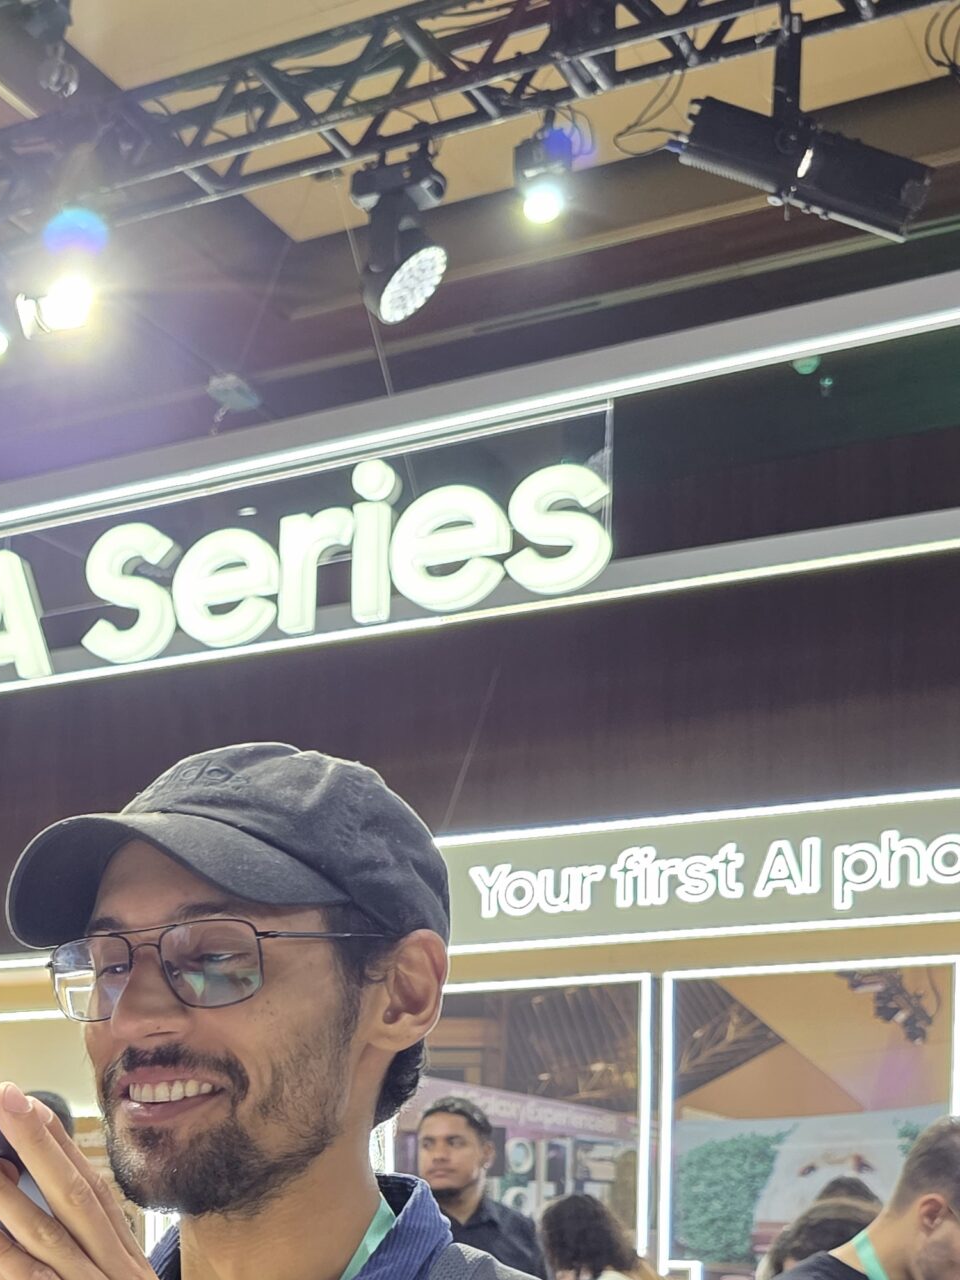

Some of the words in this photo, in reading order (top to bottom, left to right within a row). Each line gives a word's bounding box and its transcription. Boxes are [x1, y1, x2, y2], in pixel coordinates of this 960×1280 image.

[81, 458, 614, 663] Series
[469, 863, 606, 918] Your
[609, 842, 744, 907] first
[753, 836, 821, 898] AI
